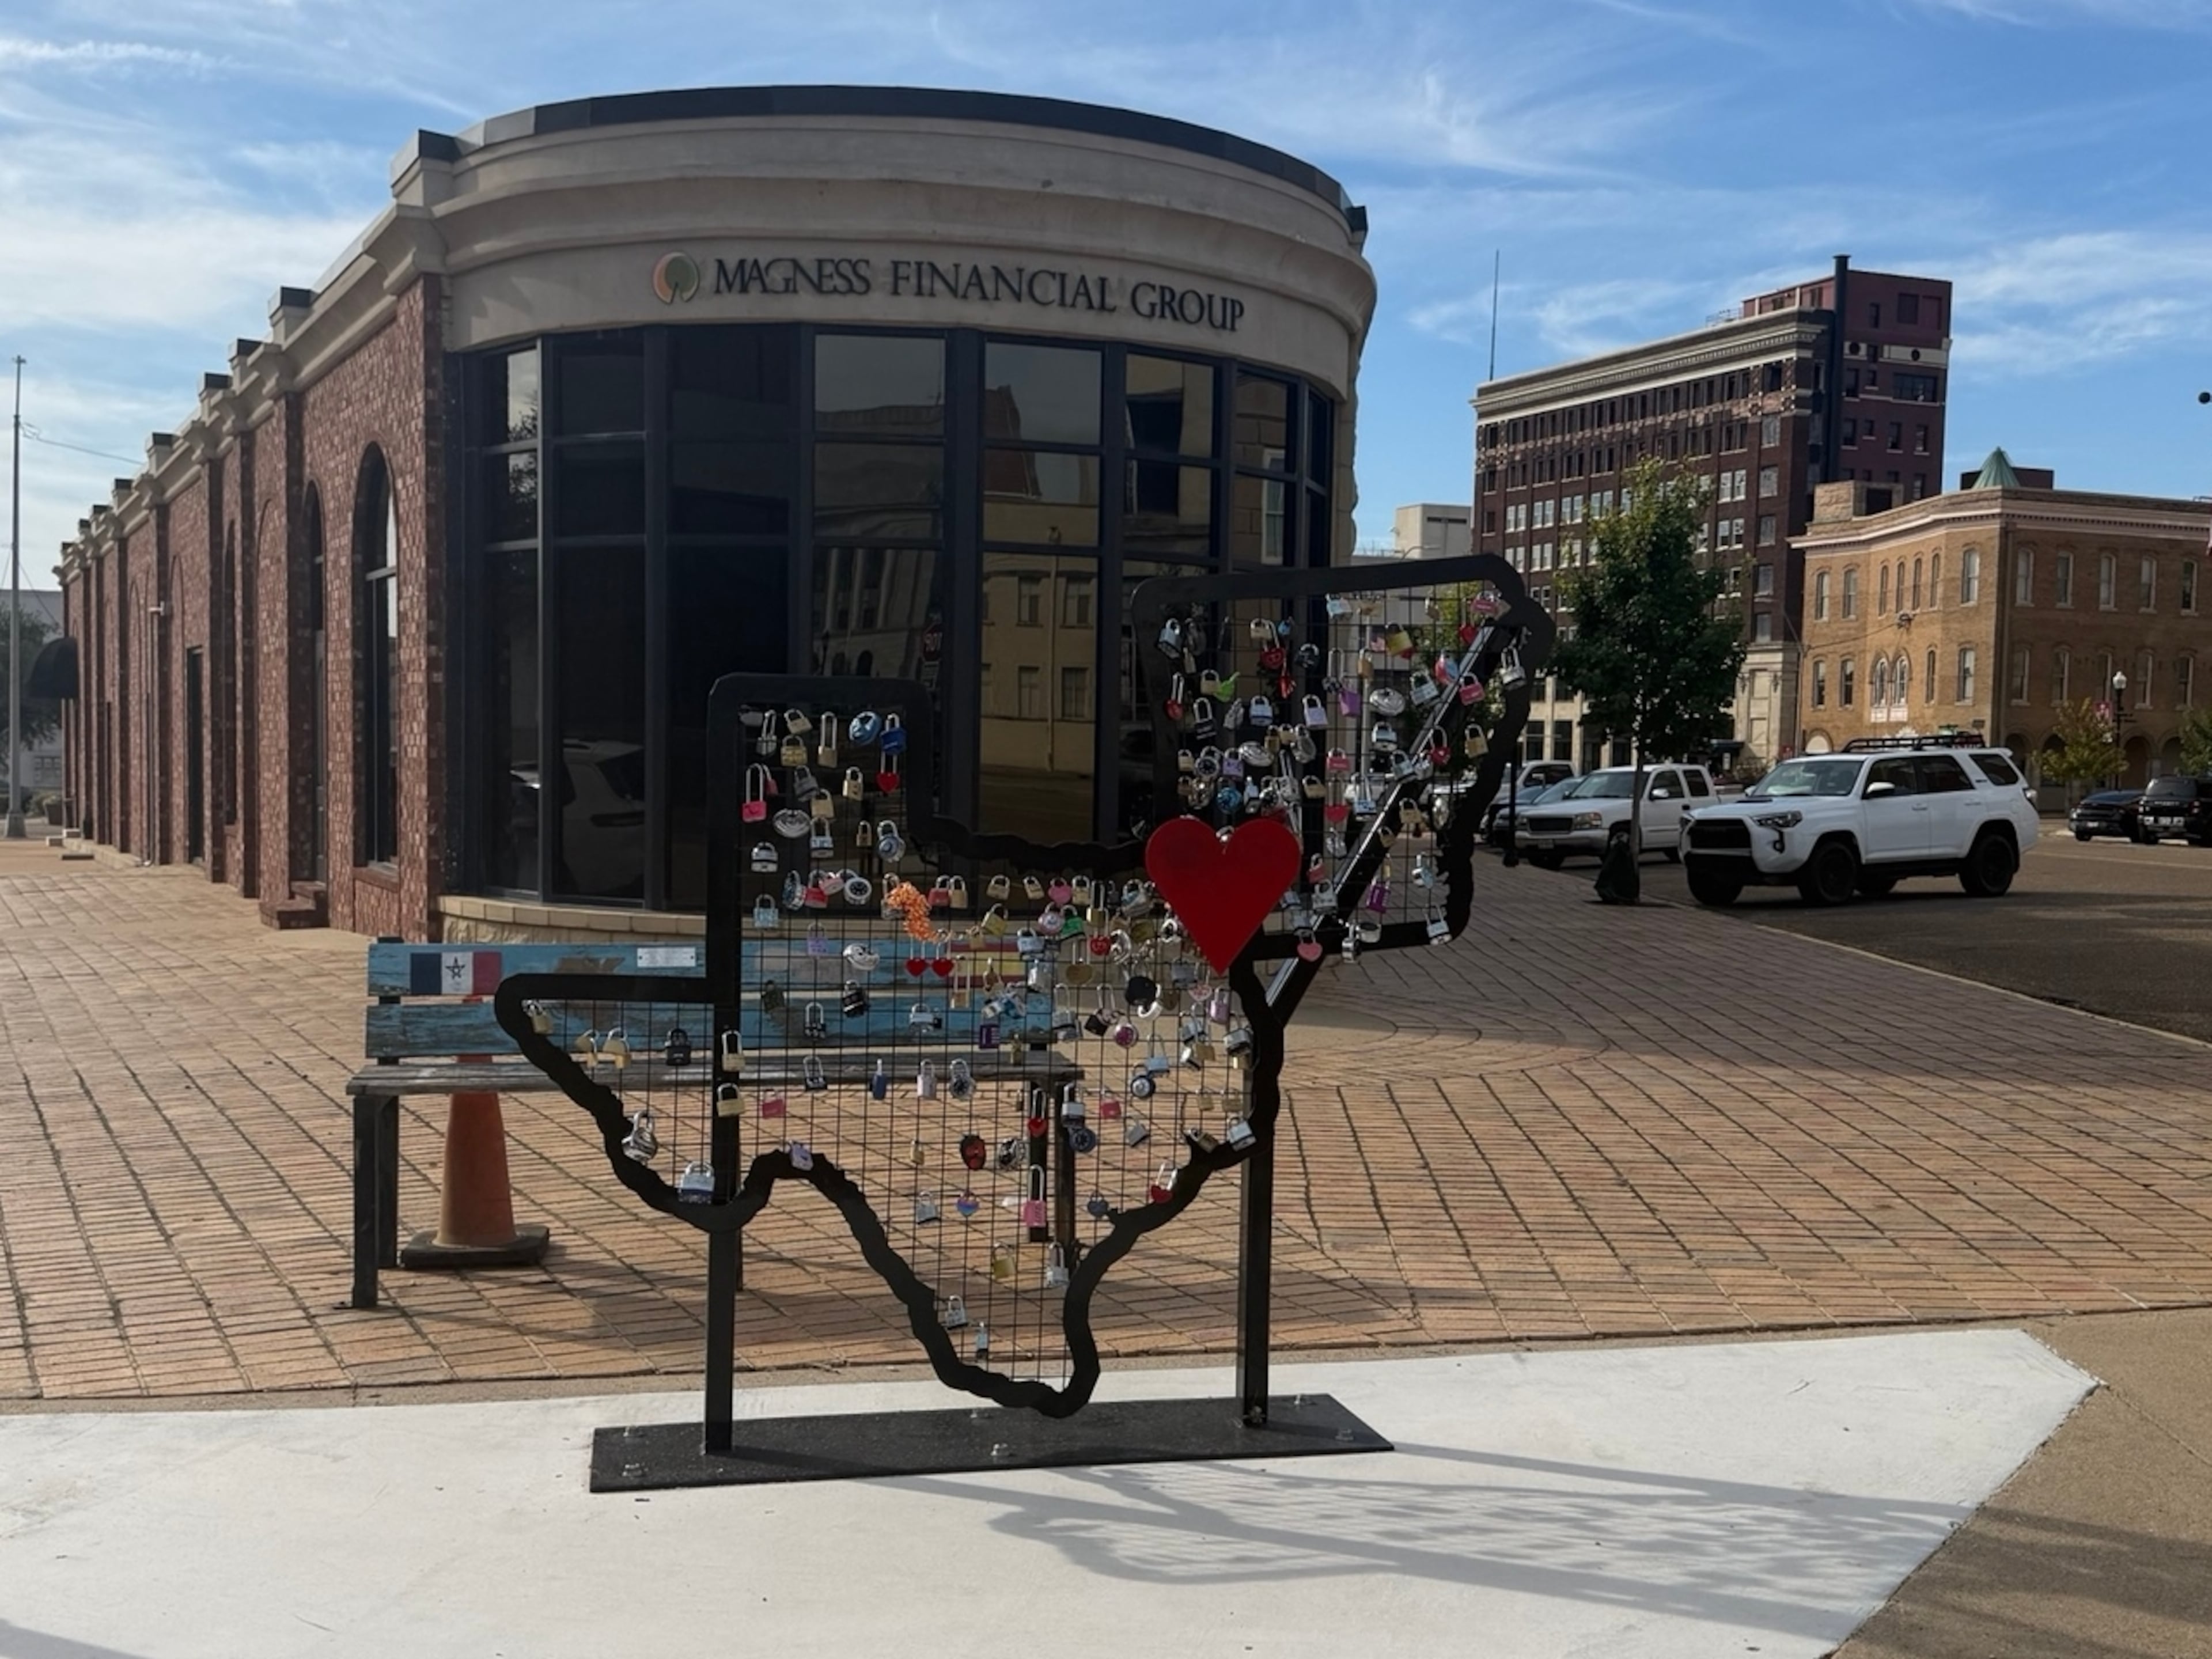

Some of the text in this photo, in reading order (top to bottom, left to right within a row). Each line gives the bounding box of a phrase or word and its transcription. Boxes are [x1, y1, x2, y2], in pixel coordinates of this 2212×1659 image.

[714, 257, 1245, 332] MAGNESS FINANCIAL GROUP
